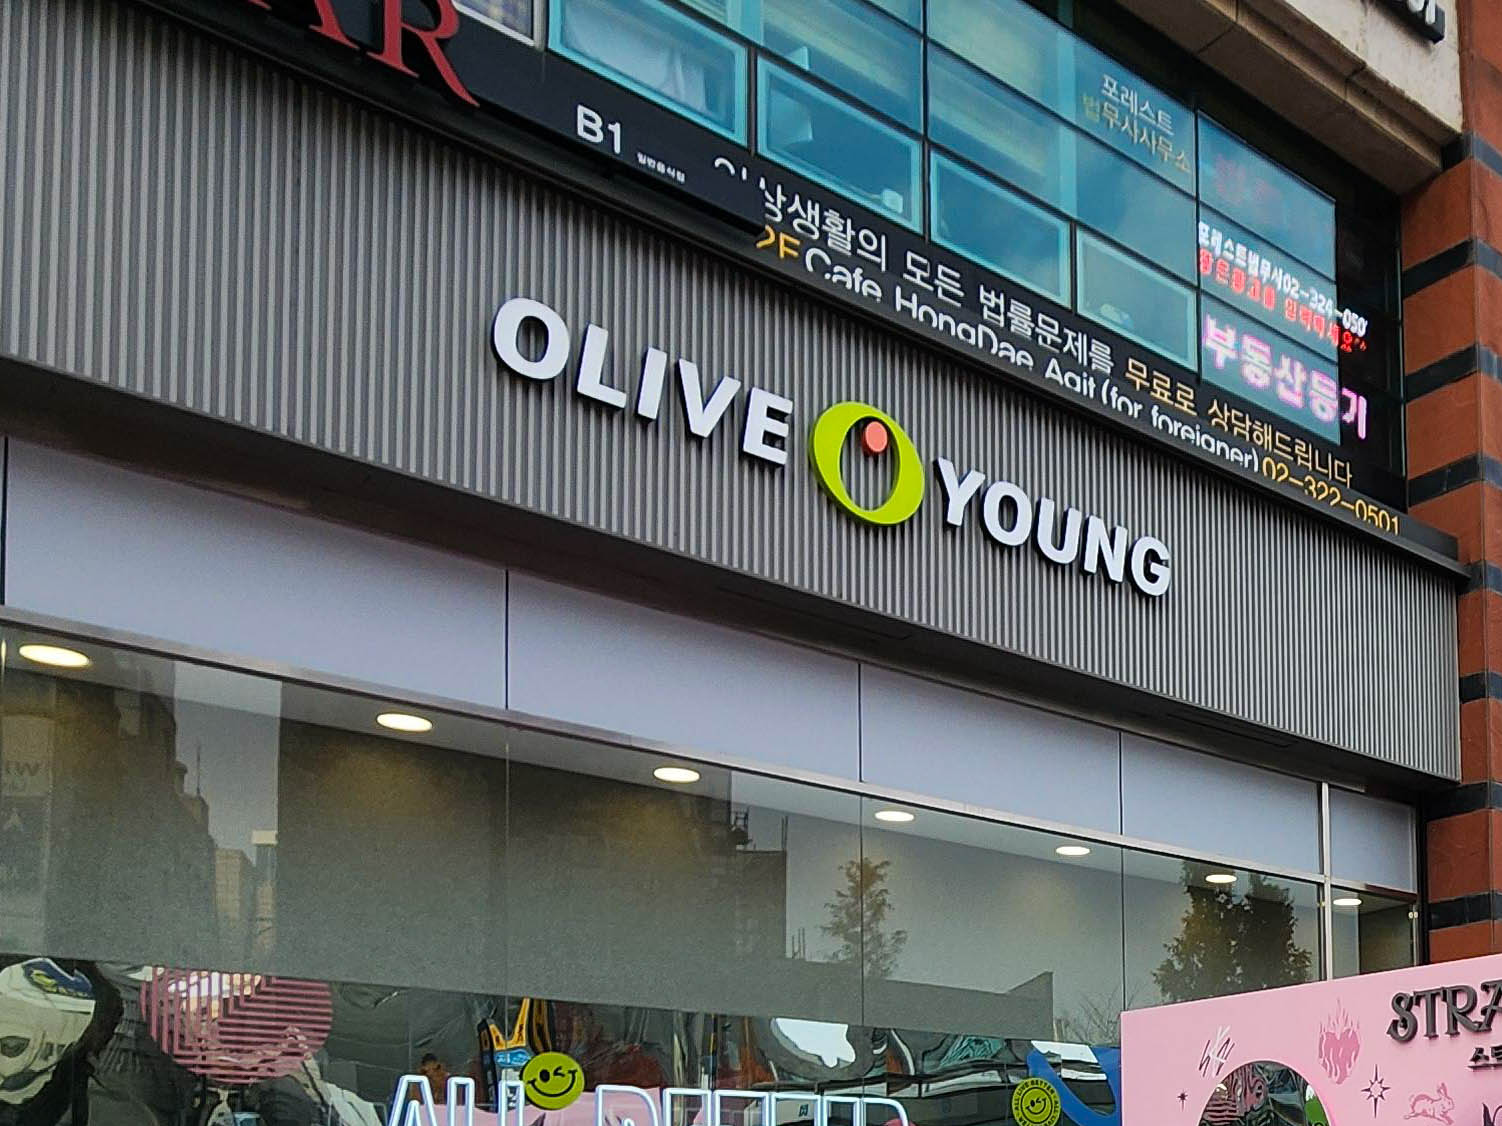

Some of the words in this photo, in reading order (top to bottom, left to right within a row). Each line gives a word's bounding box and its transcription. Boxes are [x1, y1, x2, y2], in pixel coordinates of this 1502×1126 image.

[577, 104, 621, 154] B1
[1101, 74, 1174, 136] 포레스트
[492, 297, 794, 467] OLIVE
[936, 456, 1173, 598] YOUNG
[805, 248, 883, 303] Cafe
[1262, 456, 1399, 536] 02-322-0501
[903, 251, 965, 308] 모든
[979, 284, 1115, 375] 법률문제를
[1124, 357, 1198, 417] 무료로
[1207, 398, 1353, 489] 상담해드립니다
[1203, 313, 1368, 441] 부동산등기
